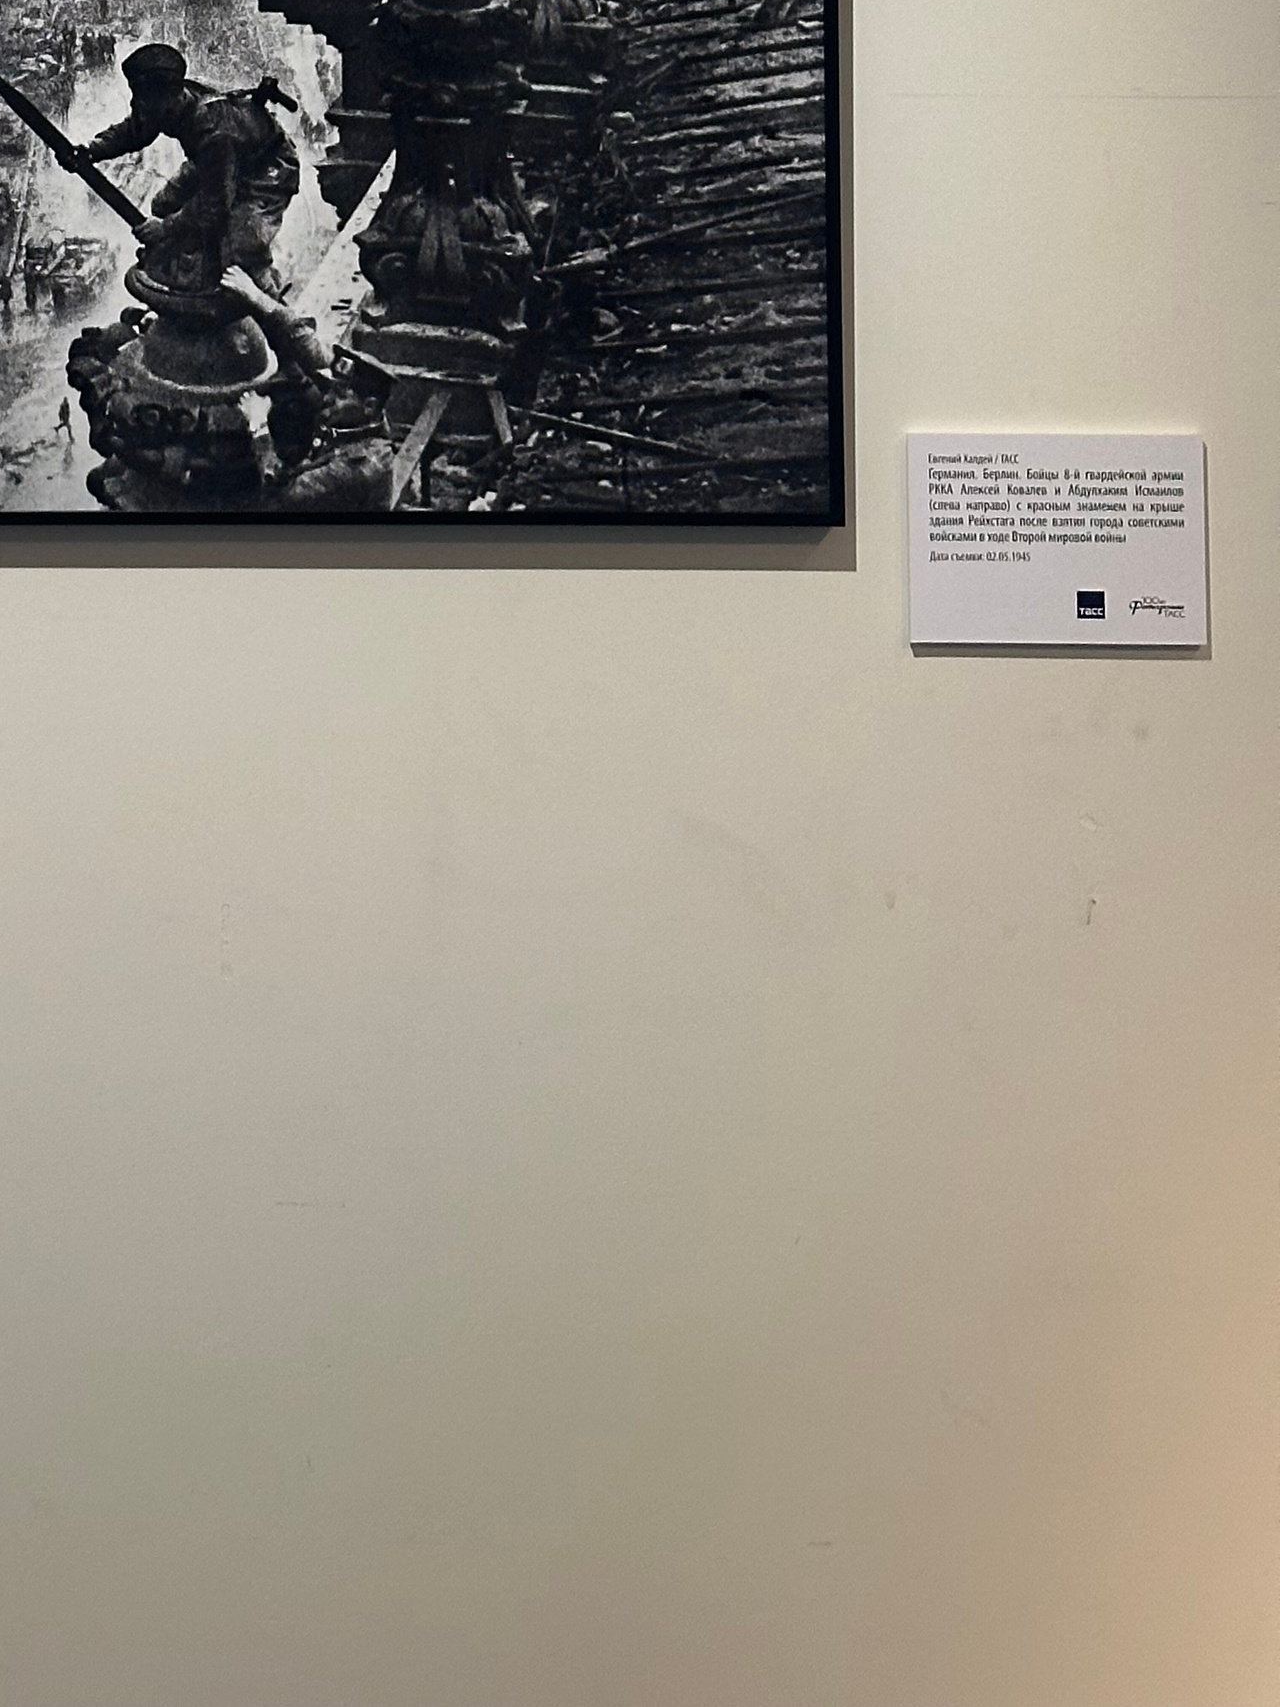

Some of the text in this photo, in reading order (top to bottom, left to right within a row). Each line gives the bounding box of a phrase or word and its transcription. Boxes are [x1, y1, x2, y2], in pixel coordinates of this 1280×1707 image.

[963, 454, 993, 465] Халдей
[1001, 454, 1019, 464] ТАСС
[928, 467, 1184, 483] Германия. Берлин. Бойцы 8-й гвардейской армии
[928, 483, 1184, 498] РККА Алексей Ковалев и Абдулхаким Исмаилов
[928, 499, 1185, 515] (слева направо) с красным знаменем на крыше
[928, 515, 1185, 530] здания Рейхстага после взятия города советскими
[929, 530, 1127, 546] войсками в ходе Второй мировой войны
[985, 551, 1031, 562] 02.05.1945
